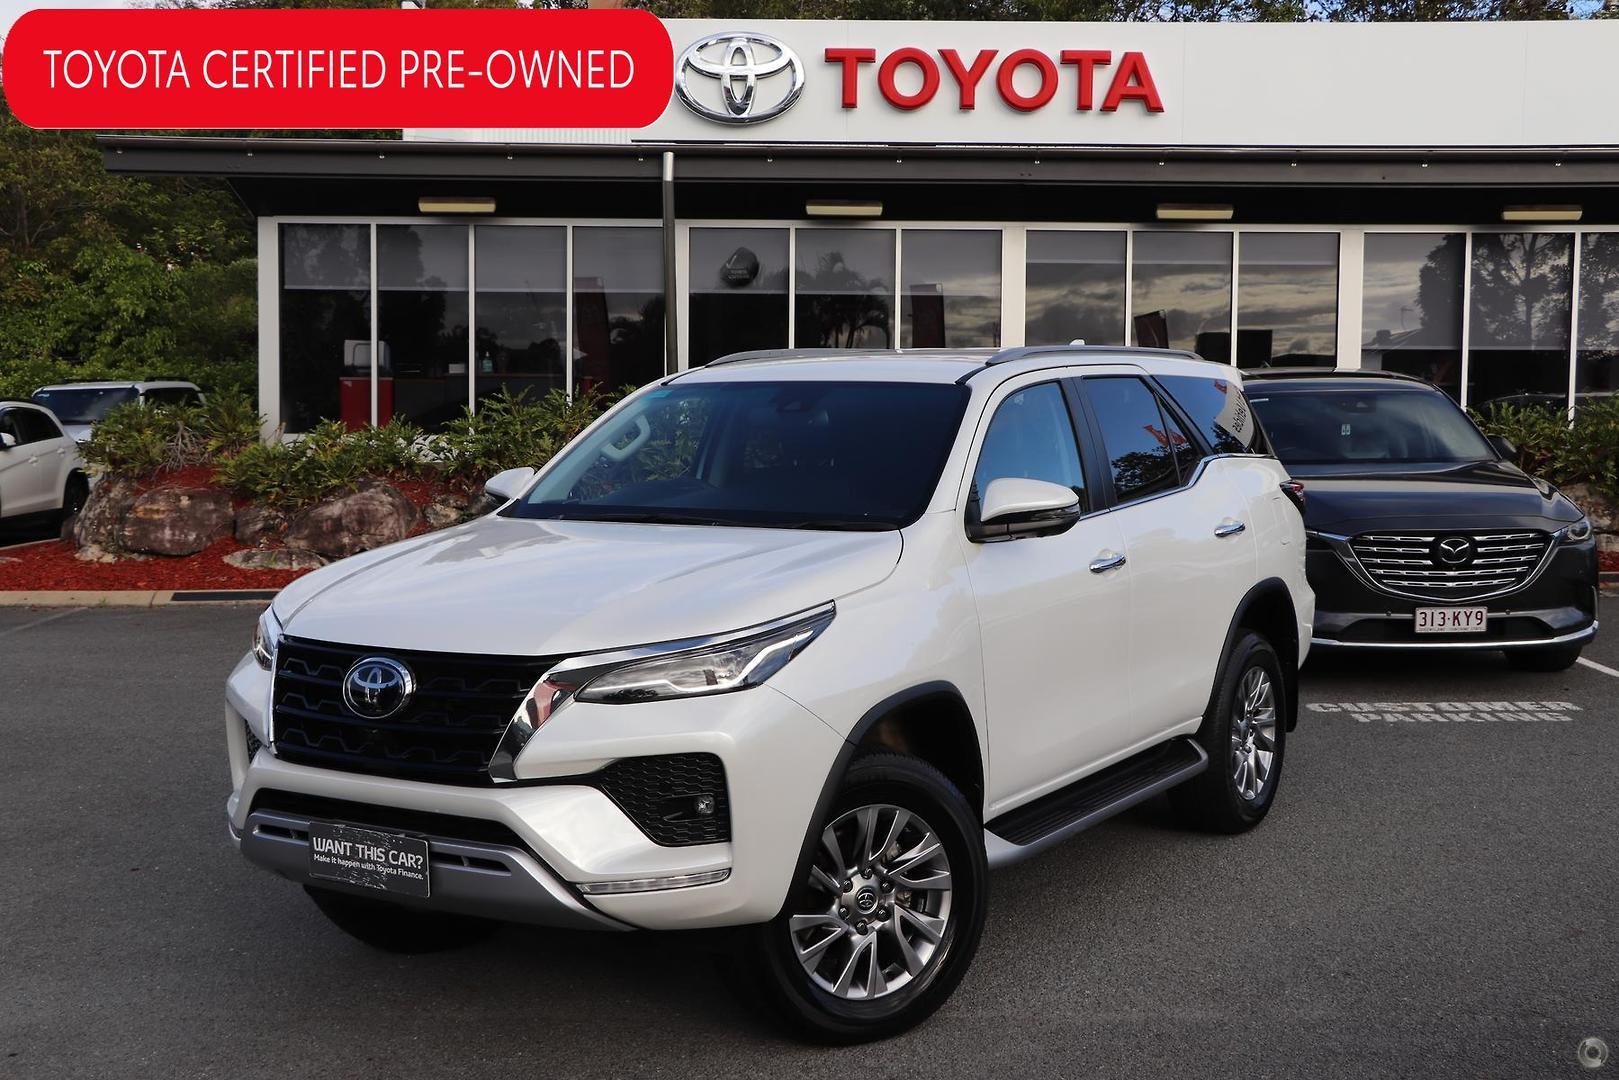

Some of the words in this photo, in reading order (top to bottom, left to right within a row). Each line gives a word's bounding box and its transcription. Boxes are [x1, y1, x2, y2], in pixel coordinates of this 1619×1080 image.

[824, 47, 1165, 113] TOYOTA
[1305, 702, 1583, 713] CUSTOMER
[1350, 712, 1573, 722] PARKING
[313, 837, 353, 856] WANT
[355, 844, 385, 862] THIS
[388, 850, 424, 869] CAR?
[313, 854, 331, 863] Make
[331, 856, 337, 864] it
[337, 858, 360, 868] happen
[361, 862, 376, 871] with
[376, 864, 397, 875] Toyota
[397, 868, 424, 880] Finance.
